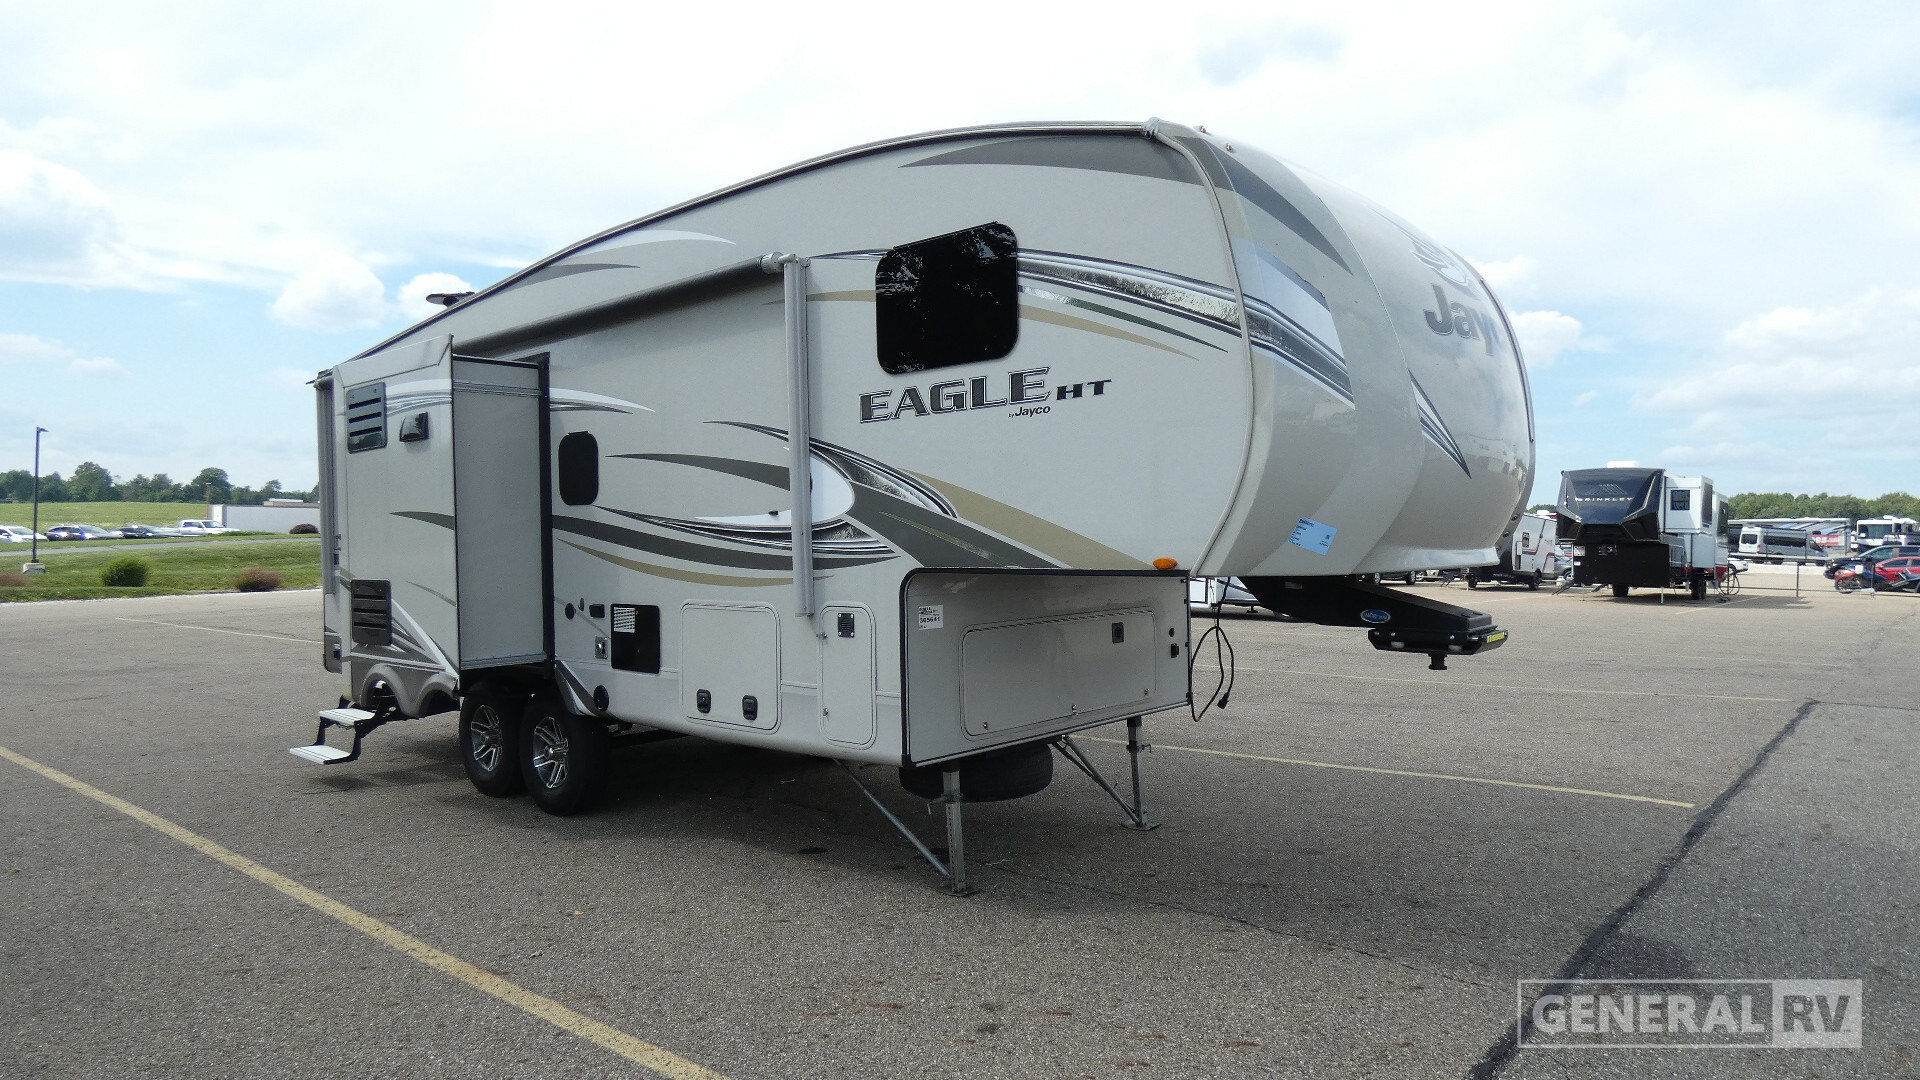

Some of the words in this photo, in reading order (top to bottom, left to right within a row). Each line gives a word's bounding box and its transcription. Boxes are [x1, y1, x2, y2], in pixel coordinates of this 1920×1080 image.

[859, 366, 1051, 424] EAGLE
[1056, 378, 1112, 401] HT
[1014, 405, 1051, 418] Jayco
